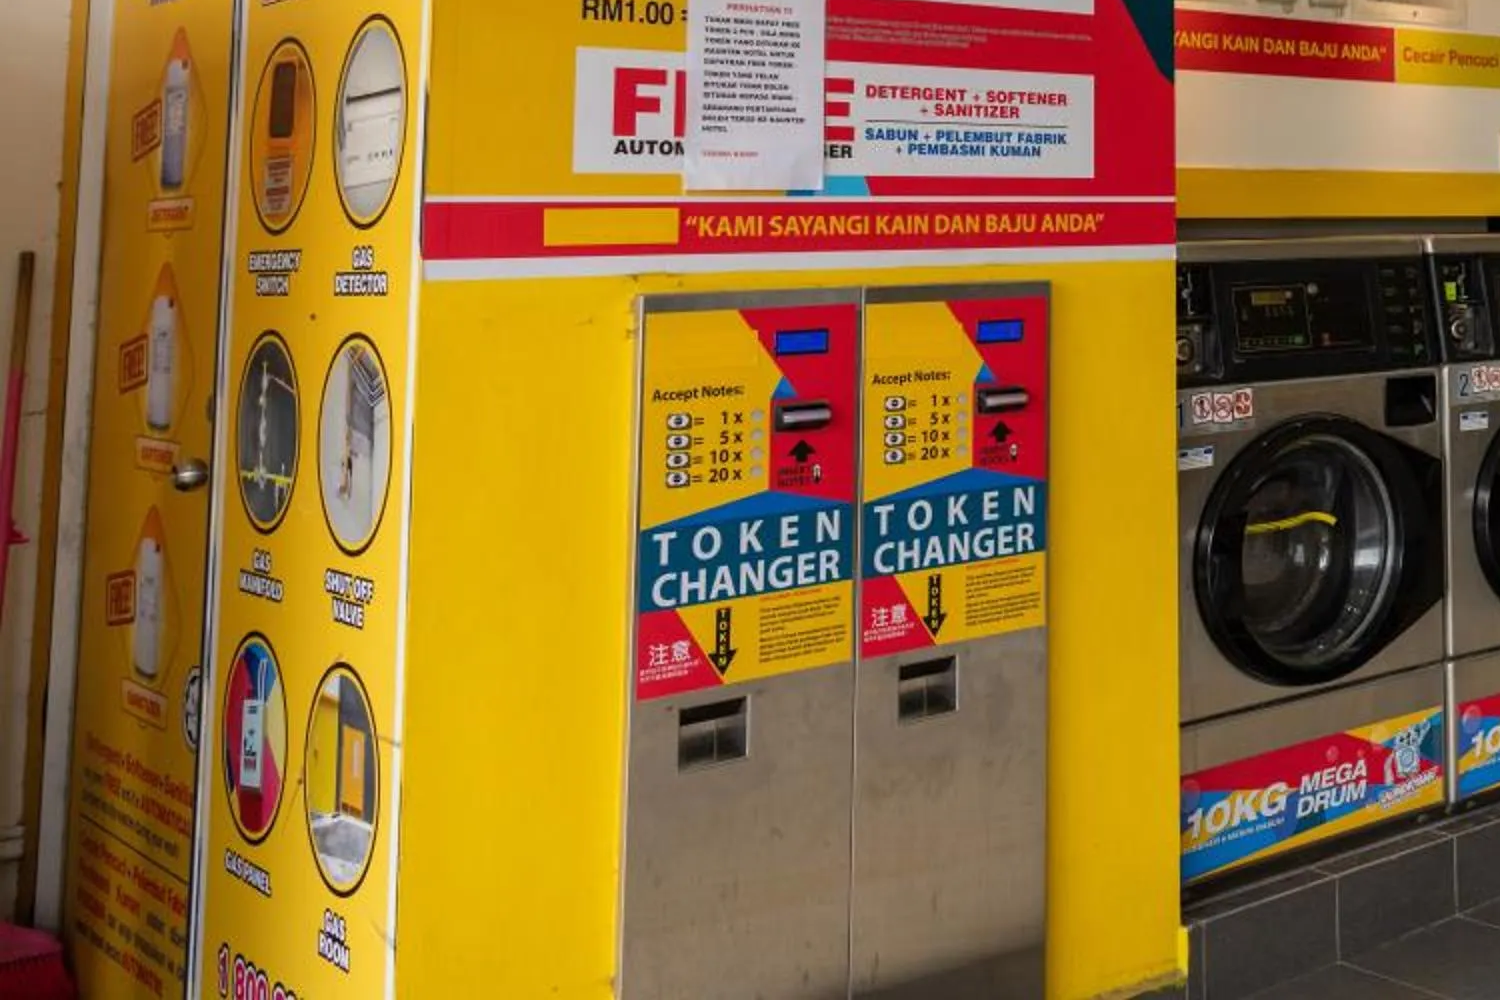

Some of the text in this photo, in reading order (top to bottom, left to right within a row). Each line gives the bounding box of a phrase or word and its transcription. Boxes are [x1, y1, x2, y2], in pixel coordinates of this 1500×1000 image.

[1223, 34, 1338, 59] KAIN DAN BAJU
[1403, 46, 1445, 64] Cecair
[1450, 50, 1499, 70] Pencuci
[865, 84, 1068, 107] DETERGENT SOFTENER
[934, 103, 1020, 119] SANITIZER
[865, 127, 1067, 145] SABUN PELEMBUT FABRIK
[908, 143, 1042, 158] PEMBASMI KUMAN
[686, 211, 1105, 239] “KAMI SAYANGI KAIN DAN BAJU ANDA”
[352, 246, 374, 270] GAS
[334, 271, 388, 297] DETECTOR
[872, 370, 951, 386] Accept Notes:
[653, 384, 745, 403] Accept Notes:
[921, 430, 939, 444] 10
[710, 450, 729, 465] 10
[921, 447, 939, 461] 20
[709, 469, 730, 483] 20
[873, 485, 1036, 537] TOKEN
[652, 508, 842, 566] TOKEN
[873, 522, 1036, 575] CHANGER
[651, 549, 841, 609] CHANGER
[1184, 782, 1290, 840] 10KG
[1299, 759, 1368, 795] MEGA
[1296, 783, 1368, 818] DRUM
